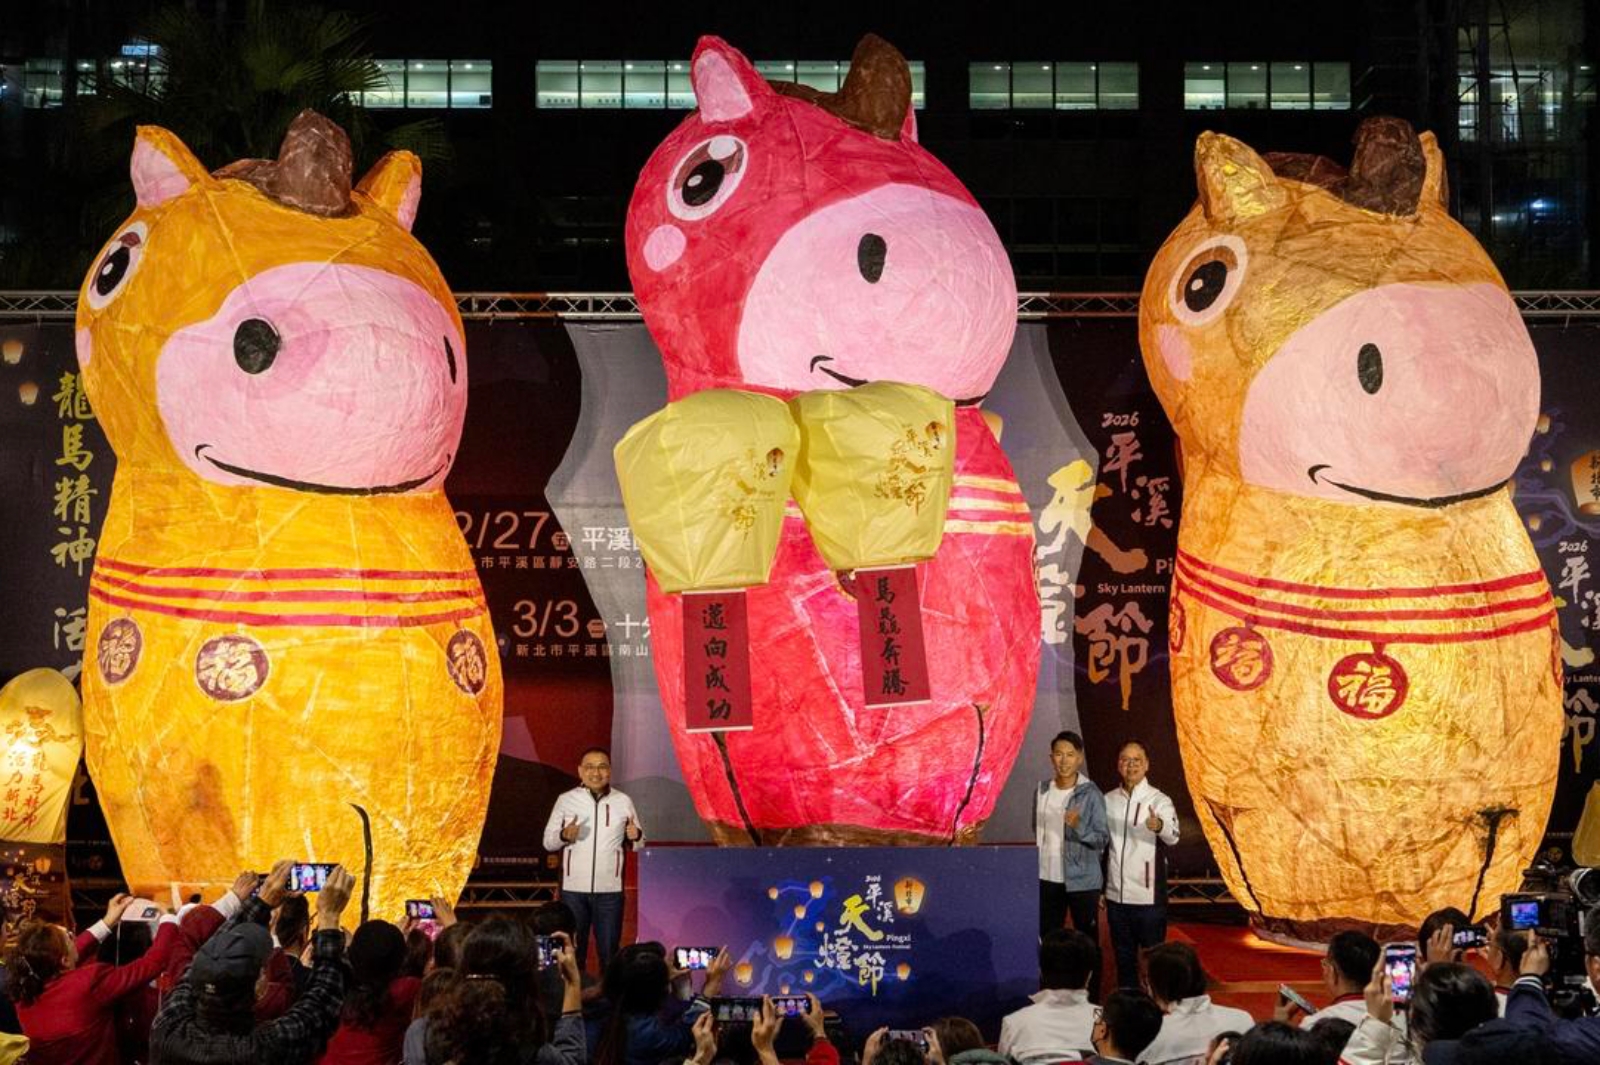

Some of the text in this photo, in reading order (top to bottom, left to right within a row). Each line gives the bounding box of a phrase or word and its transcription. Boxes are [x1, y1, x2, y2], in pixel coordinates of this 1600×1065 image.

[1102, 411, 1139, 427] 2026
[51, 371, 96, 577] 龍馬精神
[582, 526, 638, 551] 平溪
[1156, 557, 1173, 574] Pi
[1097, 583, 1165, 596] Sky Lantern
[513, 600, 579, 637] 3/3
[702, 602, 731, 720] 邁向成功
[1335, 660, 1397, 714] 福
[814, 894, 886, 996] 天燈節
